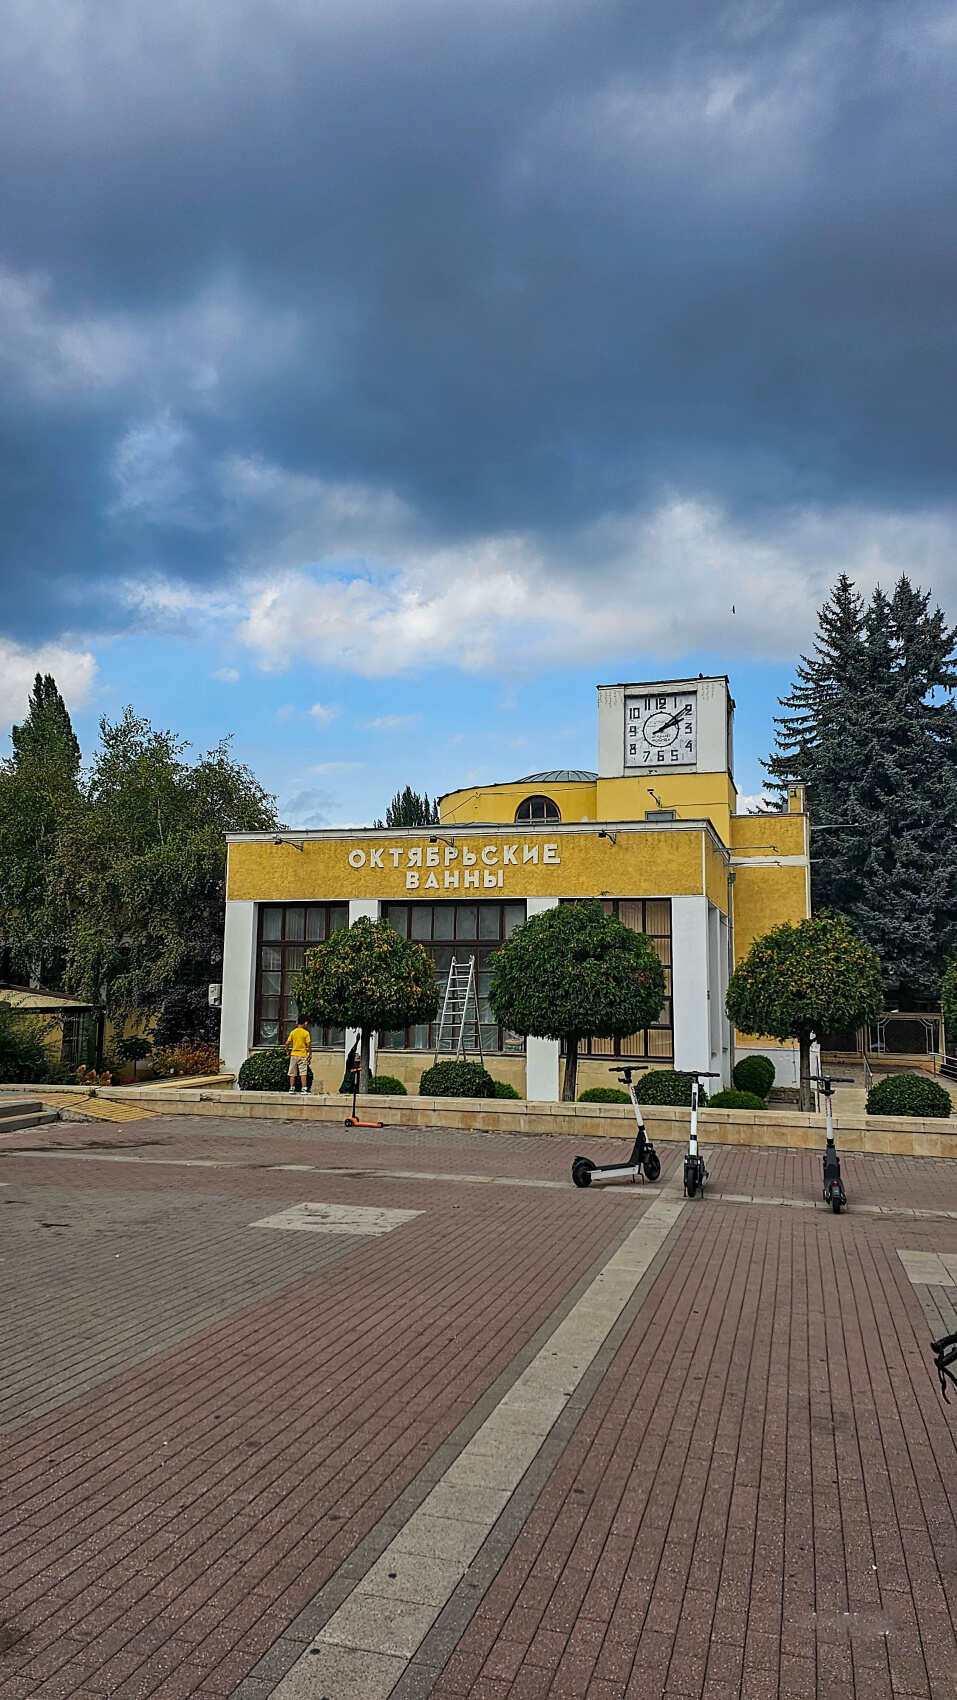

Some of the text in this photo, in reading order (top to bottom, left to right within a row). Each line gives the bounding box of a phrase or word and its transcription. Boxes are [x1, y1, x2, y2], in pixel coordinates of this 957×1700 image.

[644, 698, 651, 711] 11
[655, 697, 667, 710] 12
[629, 707, 640, 719] 10
[684, 704, 693, 716] 2
[629, 726, 637, 737] 9
[684, 722, 693, 735] 3
[629, 743, 637, 755] 8
[684, 740, 693, 752] 4
[643, 751, 651, 762] 7
[657, 750, 665, 762] 6
[670, 749, 679, 762] 5
[348, 843, 561, 869] ОКТЯБРЬСКИЕ
[405, 869, 504, 889] ВАННЫ
